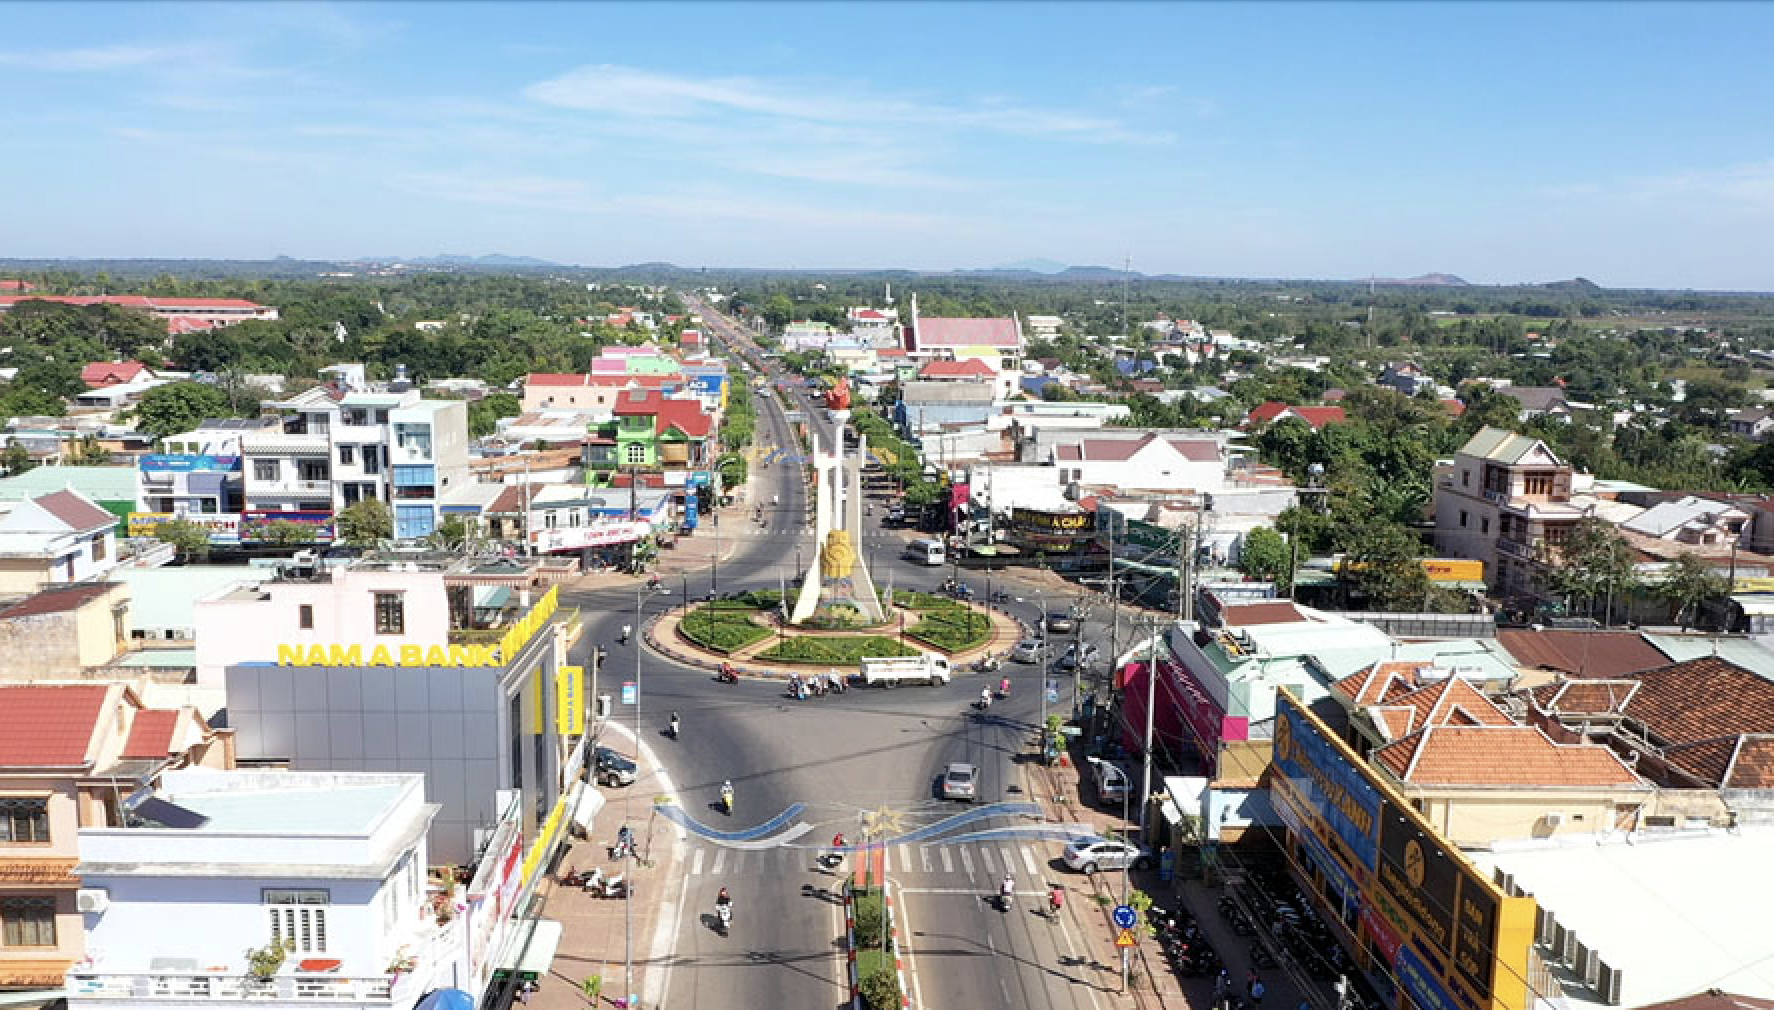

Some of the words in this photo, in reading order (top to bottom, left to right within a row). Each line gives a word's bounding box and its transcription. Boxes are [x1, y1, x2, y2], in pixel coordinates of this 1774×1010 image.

[277, 643, 363, 667] NAM
[369, 643, 395, 667] A
[400, 643, 503, 667] BANK
